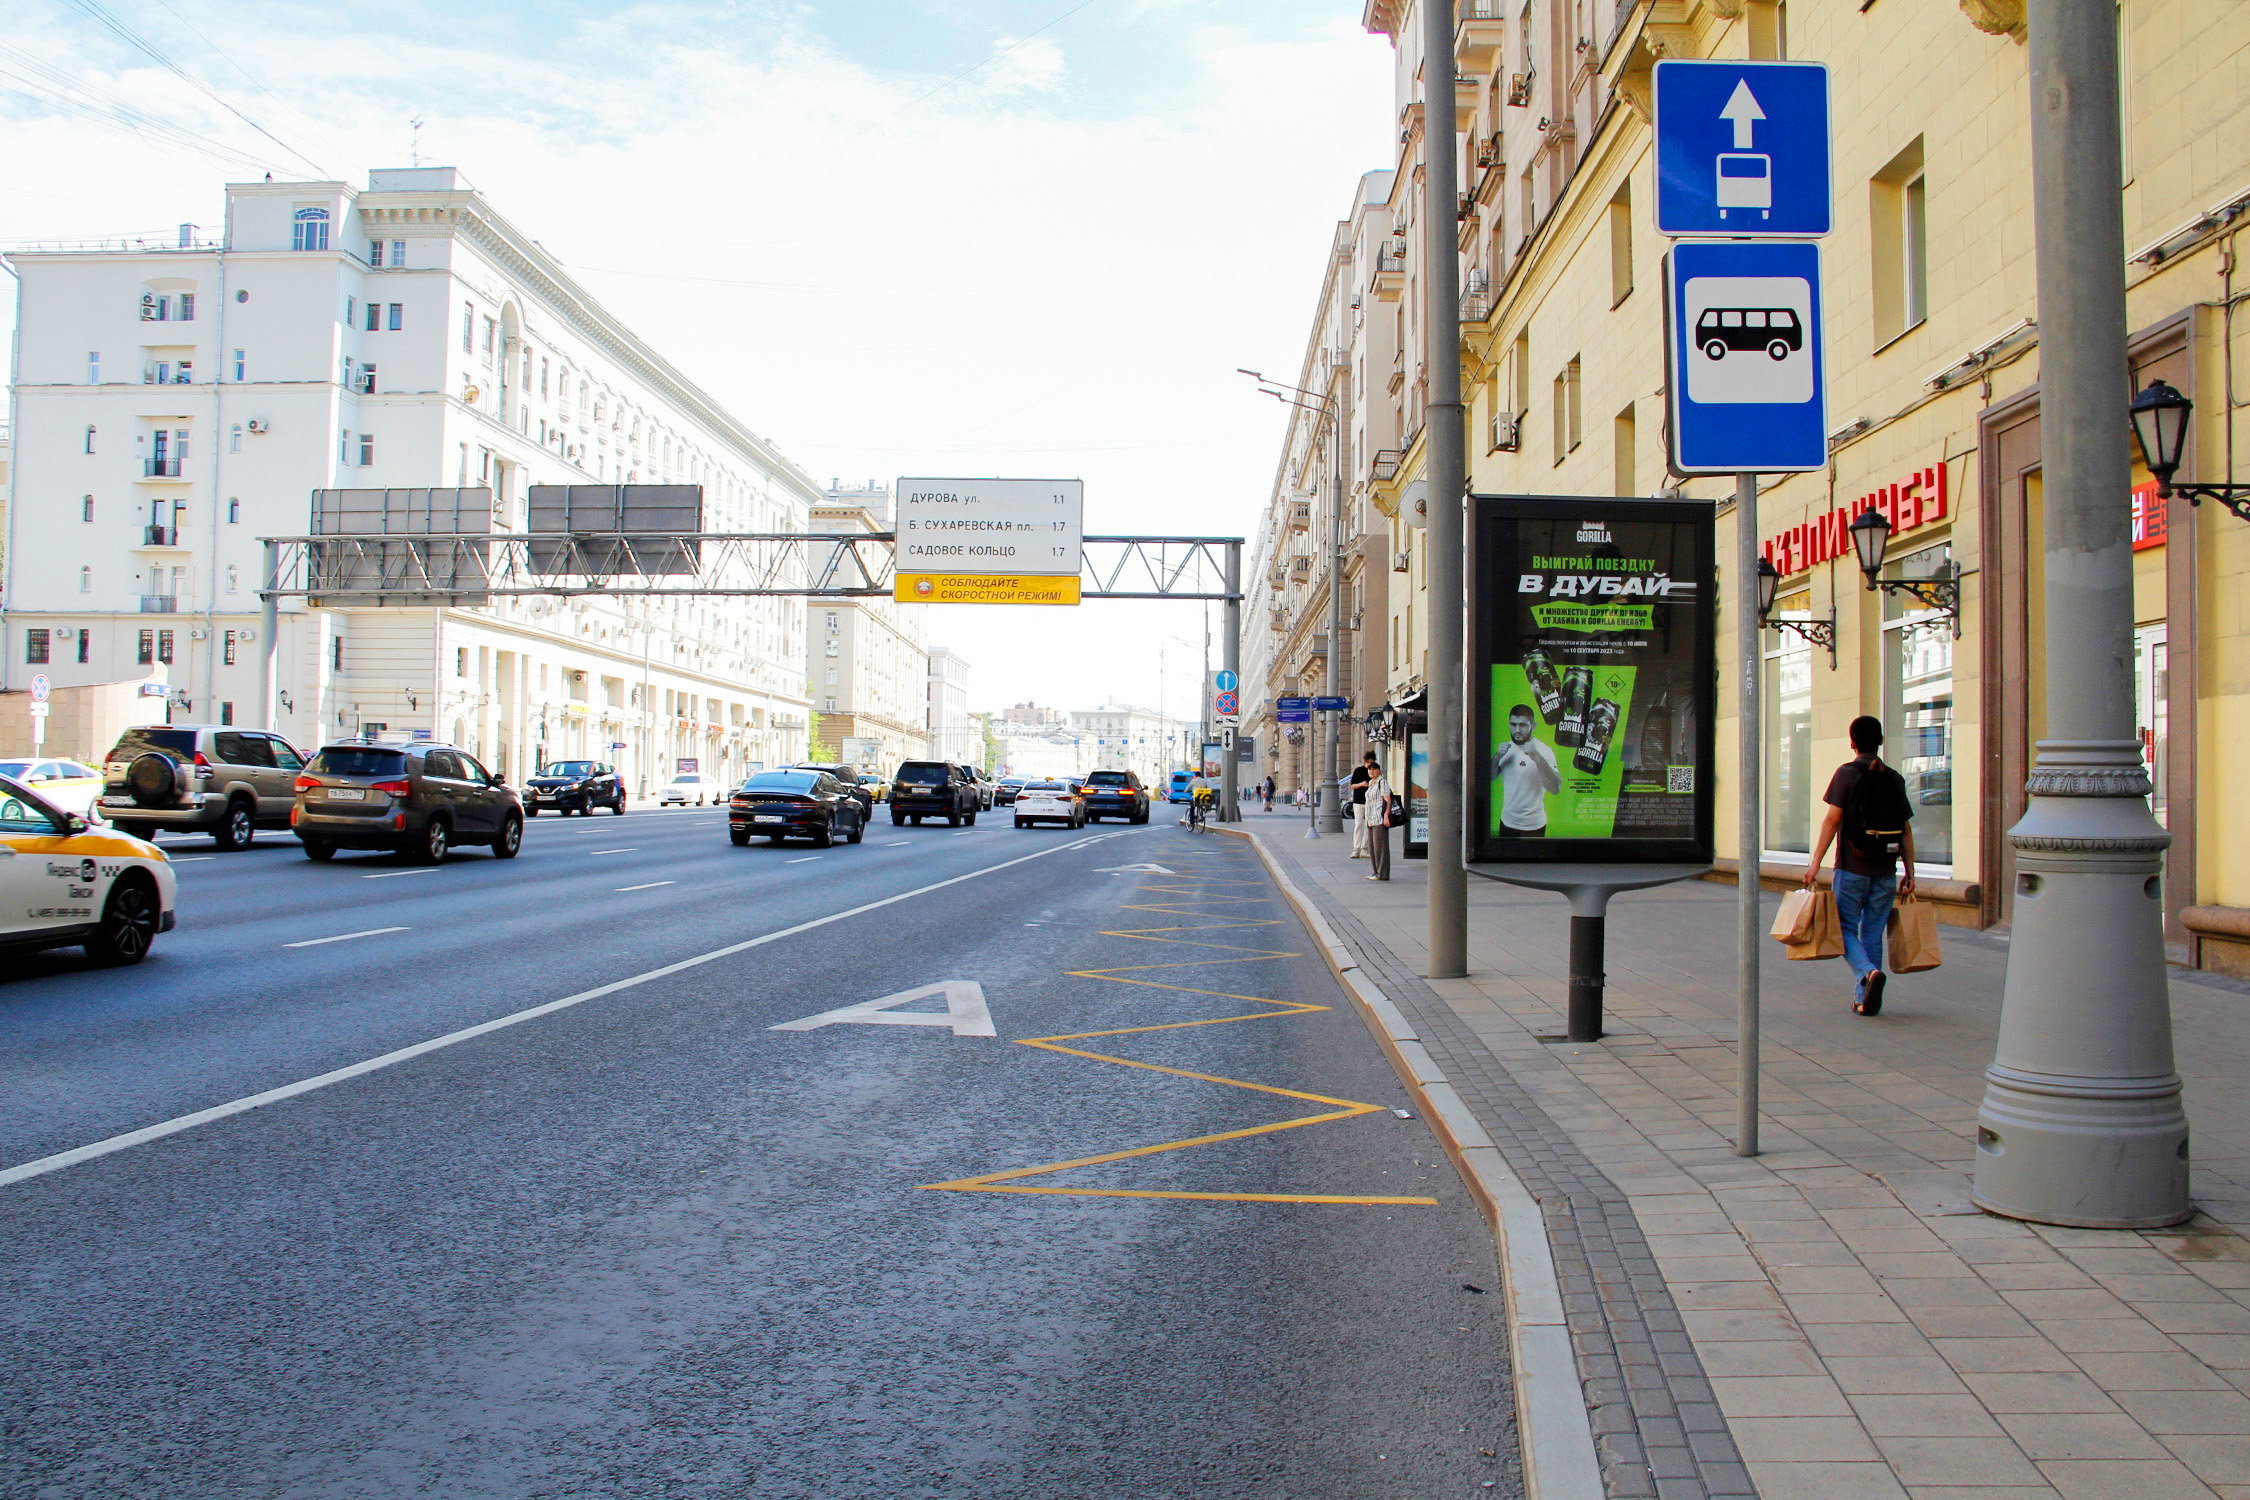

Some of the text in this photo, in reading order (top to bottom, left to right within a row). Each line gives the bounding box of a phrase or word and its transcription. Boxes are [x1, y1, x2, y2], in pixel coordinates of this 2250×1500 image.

[910, 492, 1065, 505] ДУРОВА ул. 1.1
[909, 519, 1066, 532] Б. СУХАРЕВСКАЯ пл. 1.7
[1576, 530, 1612, 543] GORILLA
[908, 544, 1065, 557] САДОВОЕ КОЛЬЦО 1.7
[1532, 554, 1656, 572] ВЫИГРАЙ ПОЕЗДКУ
[941, 577, 1019, 589] СОБЛЮДАЙТЕ
[1518, 572, 1673, 597] В ДУБАЙ
[940, 588, 1063, 602] СКОРОСТНОЙ РЕЖИМ!
[1558, 721, 1585, 735] GORILLA
[1577, 746, 1604, 764] GORILLA
